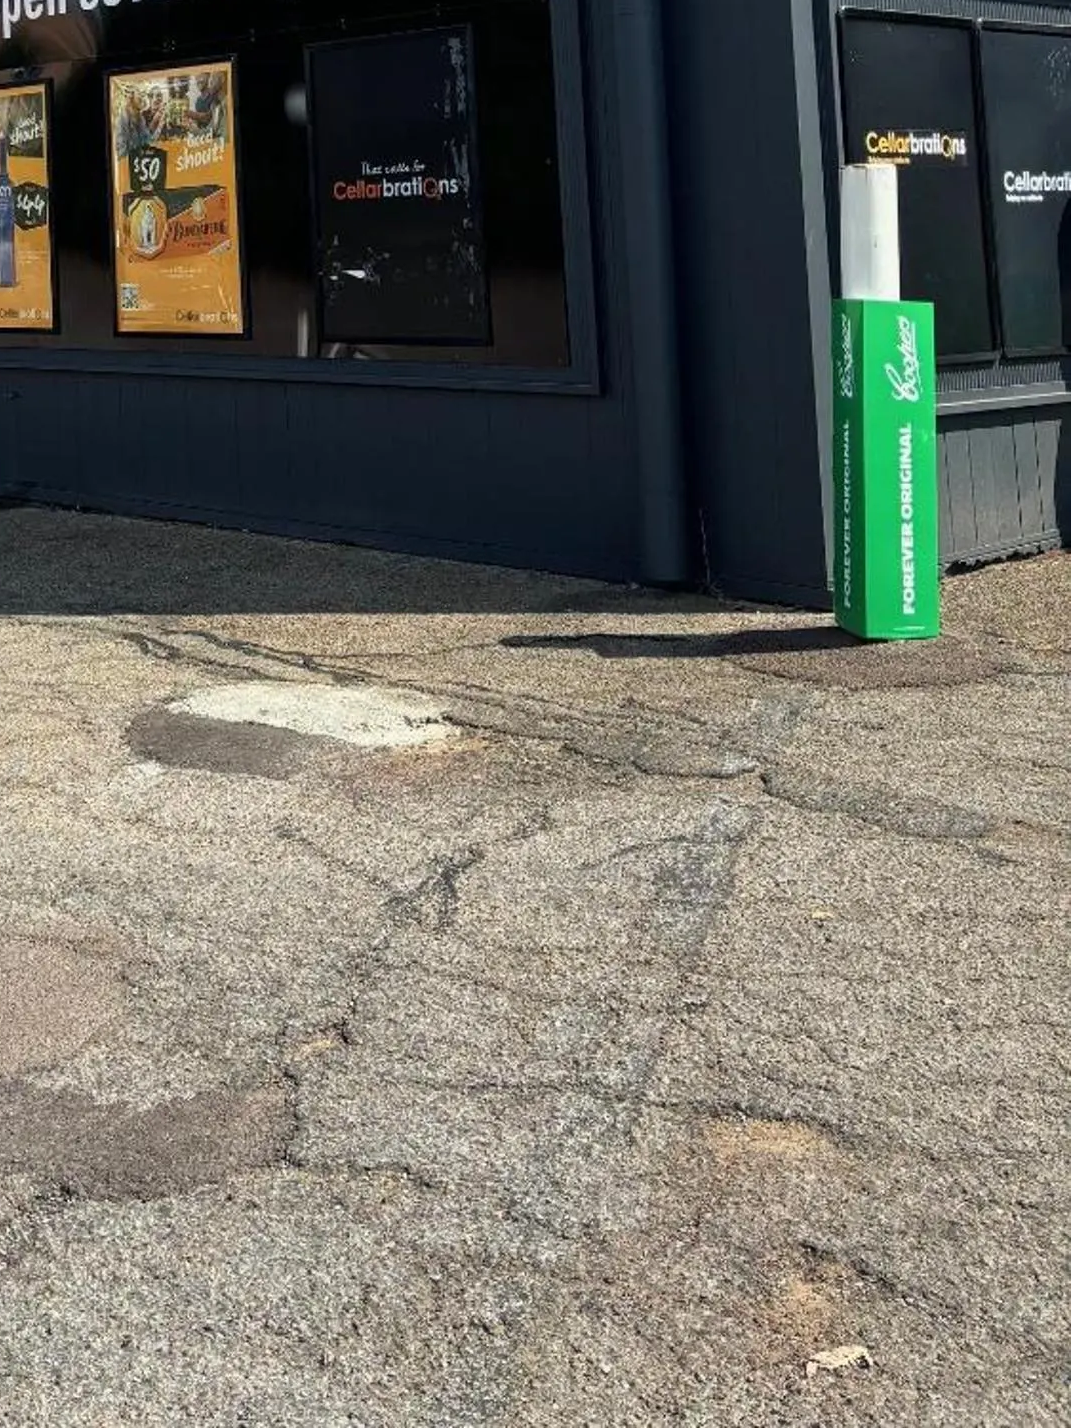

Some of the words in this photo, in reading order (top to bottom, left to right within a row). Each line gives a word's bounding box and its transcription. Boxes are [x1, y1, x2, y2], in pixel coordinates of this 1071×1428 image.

[133, 157, 160, 182] $50
[898, 423, 913, 519] ORIGINAL
[843, 517, 852, 609] FOREVER
[900, 520, 916, 615] FOREVER
